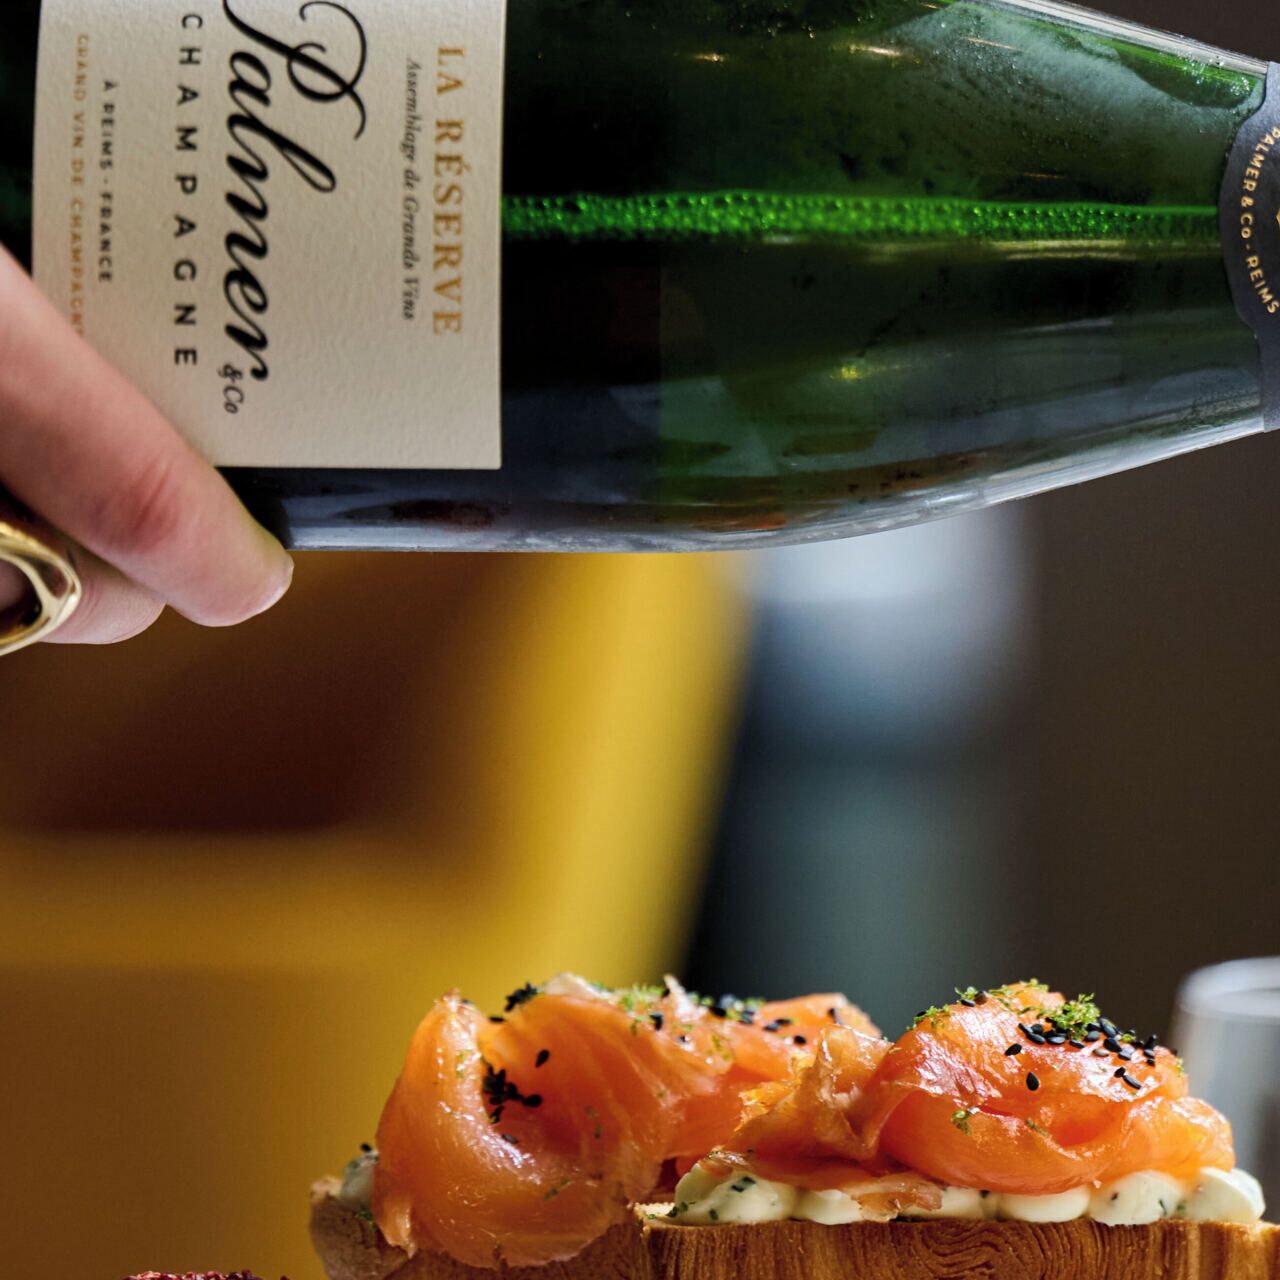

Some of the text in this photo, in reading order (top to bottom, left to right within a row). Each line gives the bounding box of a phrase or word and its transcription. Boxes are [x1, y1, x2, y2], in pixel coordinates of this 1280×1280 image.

[74, 34, 89, 102] GRAND
[72, 113, 85, 148] VIN
[100, 102, 115, 170] REIMS
[71, 159, 84, 187] DE
[173, 13, 204, 366] CHAMPAGNE
[399, 58, 421, 321] Assemblage de Grands Vins
[432, 46, 471, 337] LA RÉSERVE
[98, 192, 112, 283] FRANCE
[1245, 255, 1280, 314] REIMS
